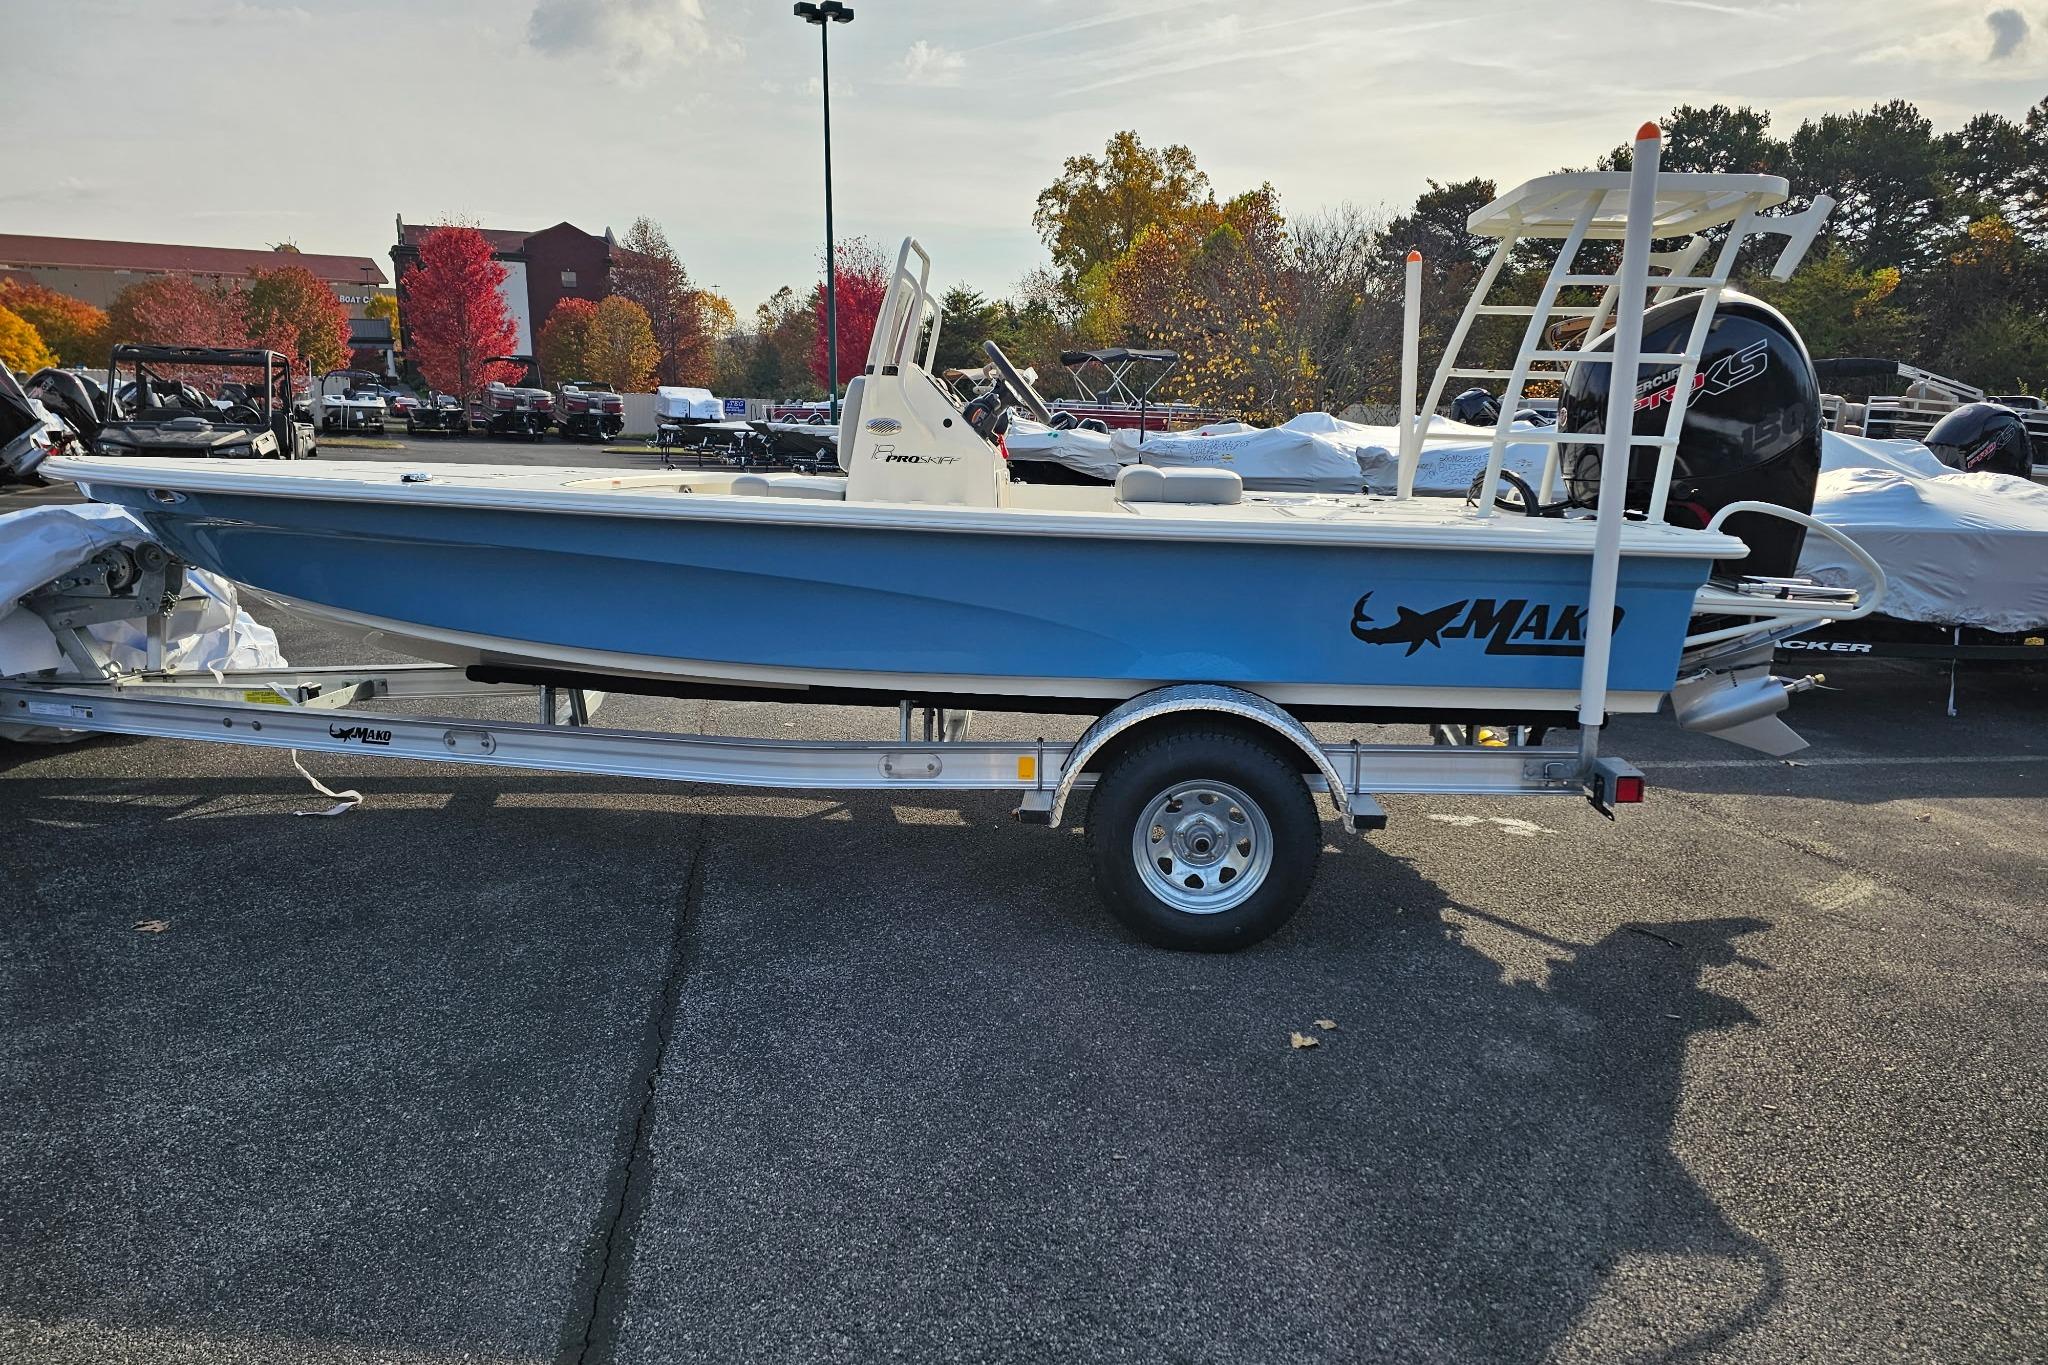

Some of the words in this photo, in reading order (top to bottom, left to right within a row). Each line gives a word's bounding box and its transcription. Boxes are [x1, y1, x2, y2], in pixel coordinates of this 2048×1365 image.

[339, 295, 361, 303] BOAT
[1635, 367, 1681, 394] ERCUR
[350, 726, 392, 746] MAKO
